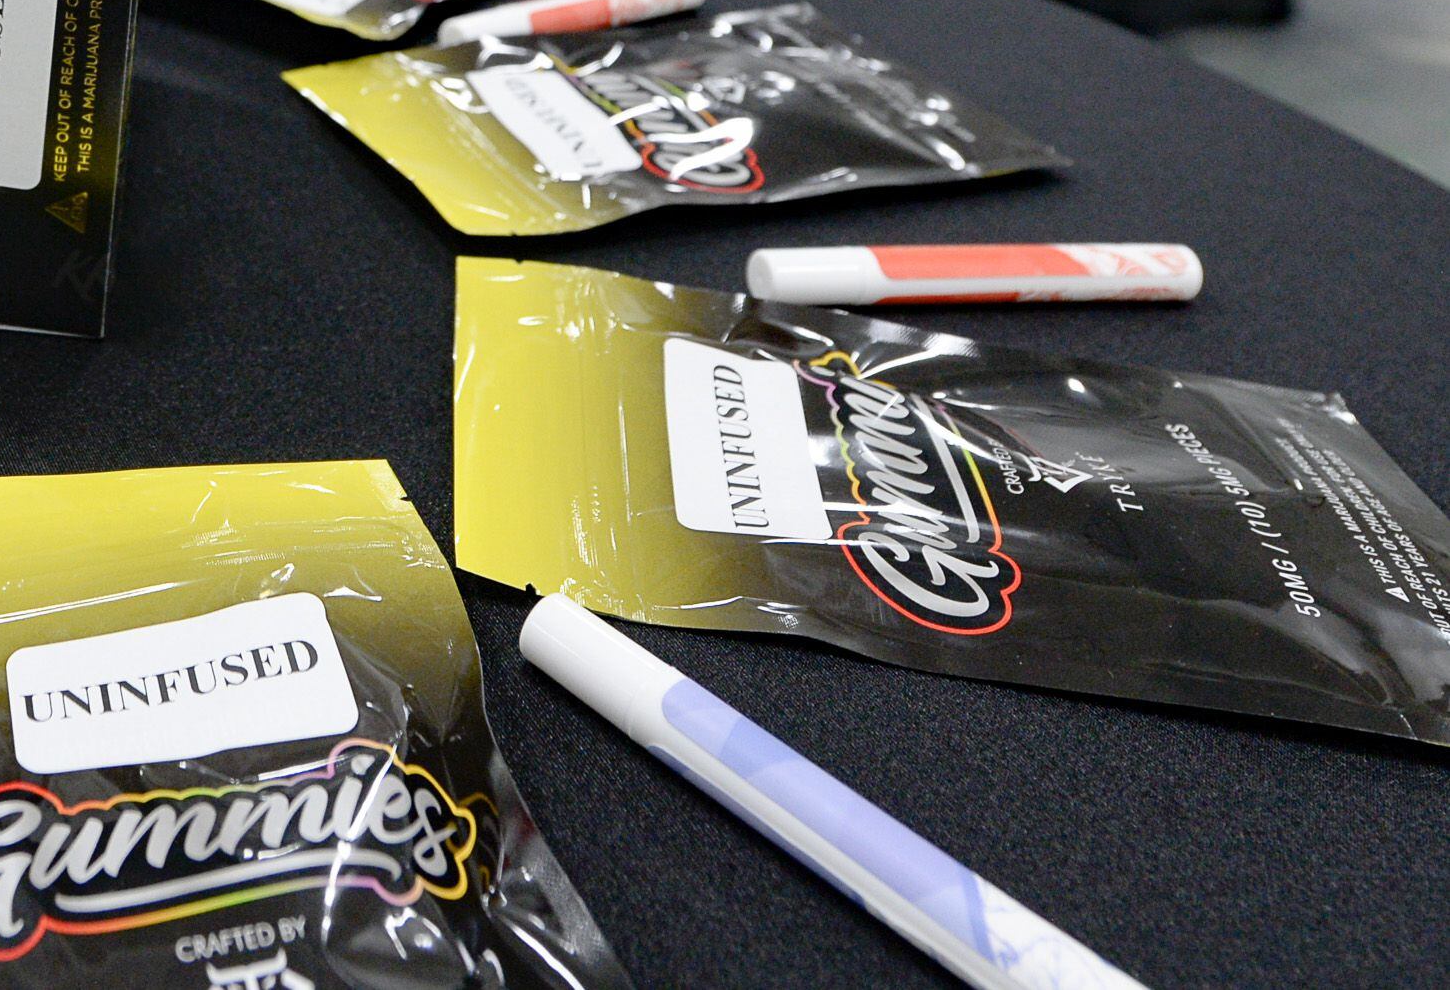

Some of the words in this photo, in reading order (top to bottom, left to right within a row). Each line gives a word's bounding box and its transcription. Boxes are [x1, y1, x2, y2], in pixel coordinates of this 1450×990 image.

[64, 11, 78, 32] OF
[61, 36, 76, 86] REACH
[83, 23, 101, 109] MARIJUANA
[59, 89, 72, 109] OF
[56, 113, 70, 143] OUT
[80, 126, 93, 139] IS
[81, 113, 94, 124] A
[53, 146, 69, 182] KEEP
[77, 142, 93, 173] THIS
[712, 364, 771, 531] UNINFUSED
[1164, 423, 1222, 466] PIECES
[1208, 466, 1251, 497] 5MG
[1235, 501, 1283, 538] (10)
[1381, 516, 1403, 533] OF
[1353, 534, 1370, 544] A
[1359, 543, 1379, 557] IS
[1377, 534, 1399, 551] OF
[1394, 533, 1430, 569] YEARS
[1368, 557, 1397, 585] THIS
[1389, 551, 1427, 592] REACH
[1271, 559, 1321, 618] 50MG
[1415, 592, 1438, 610] OF
[20, 638, 320, 724] UNINFUSED
[174, 921, 277, 964] CRAFTED
[276, 913, 307, 944] BY
